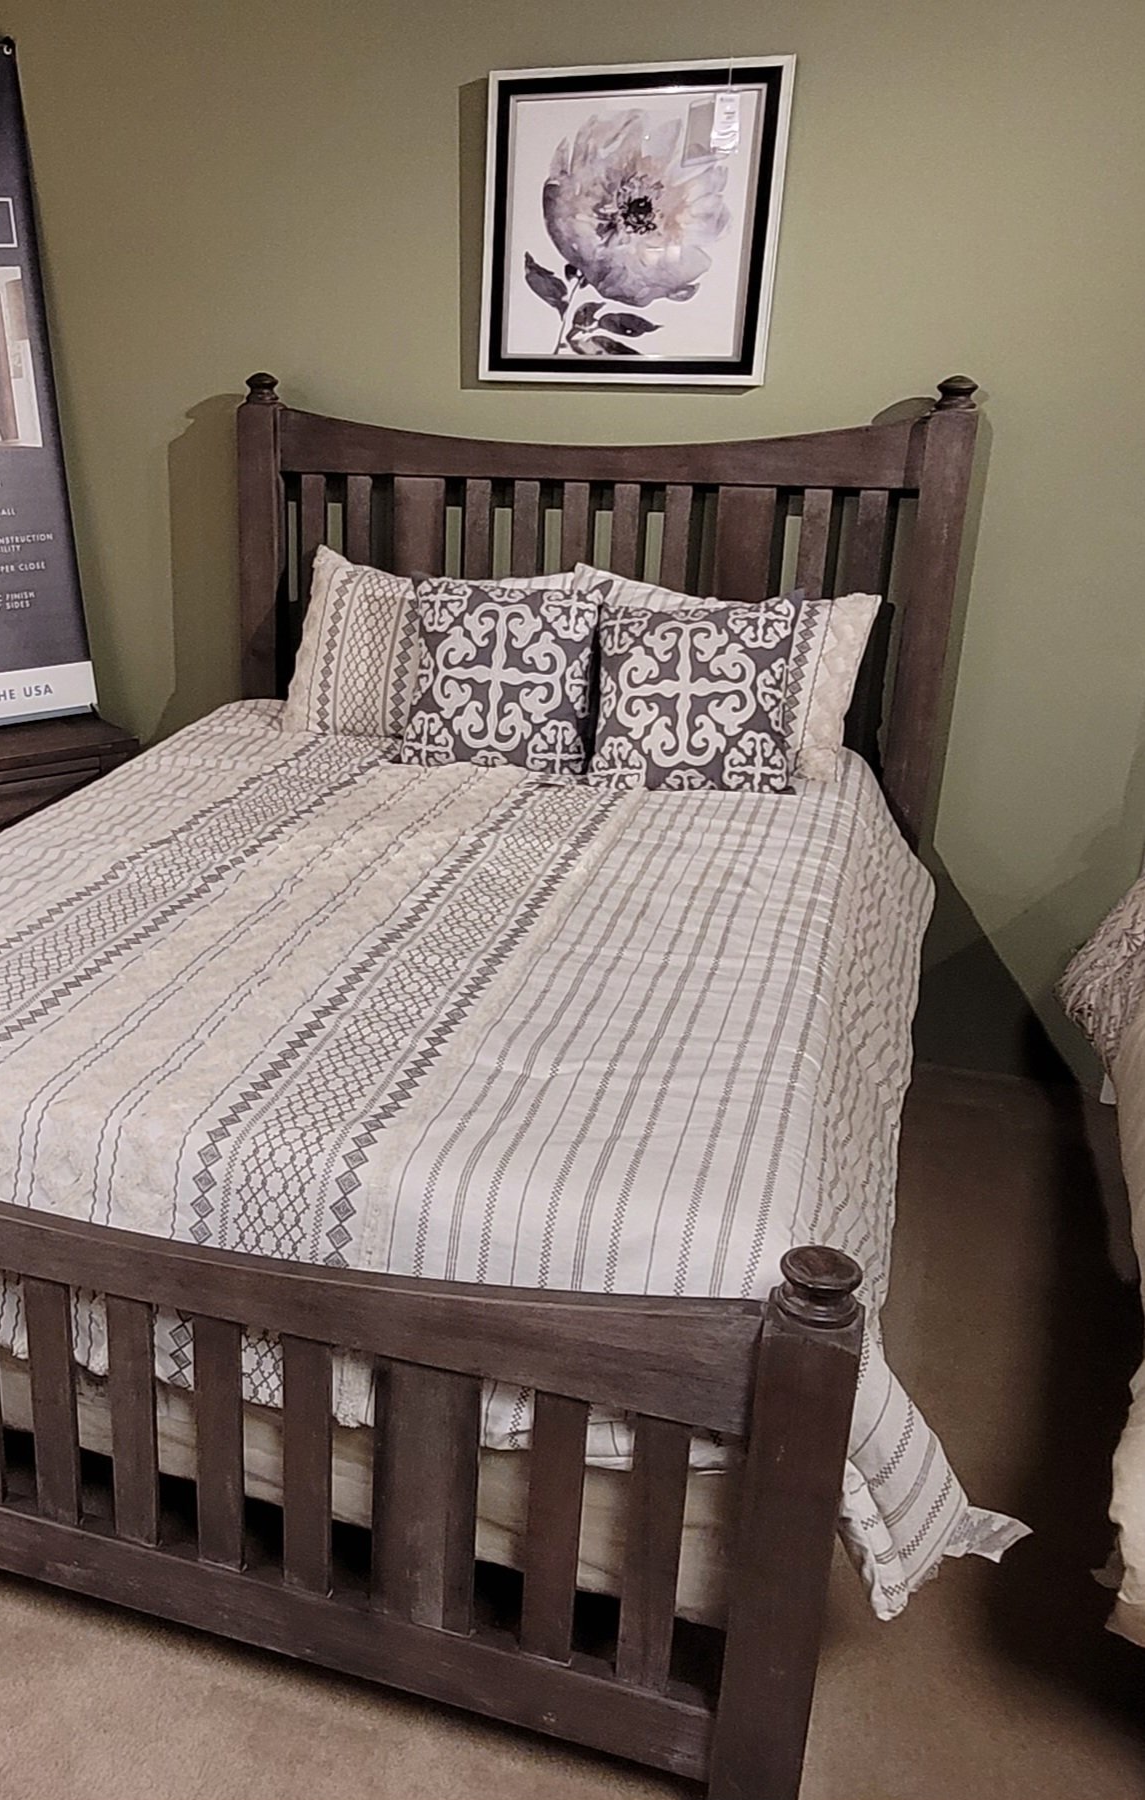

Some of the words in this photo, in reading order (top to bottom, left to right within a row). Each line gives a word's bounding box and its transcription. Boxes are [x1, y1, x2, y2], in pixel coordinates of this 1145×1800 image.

[18, 561, 46, 572] CLOSE
[6, 591, 35, 601] FINISH
[6, 600, 30, 610] SIDES
[23, 684, 53, 698] USA
